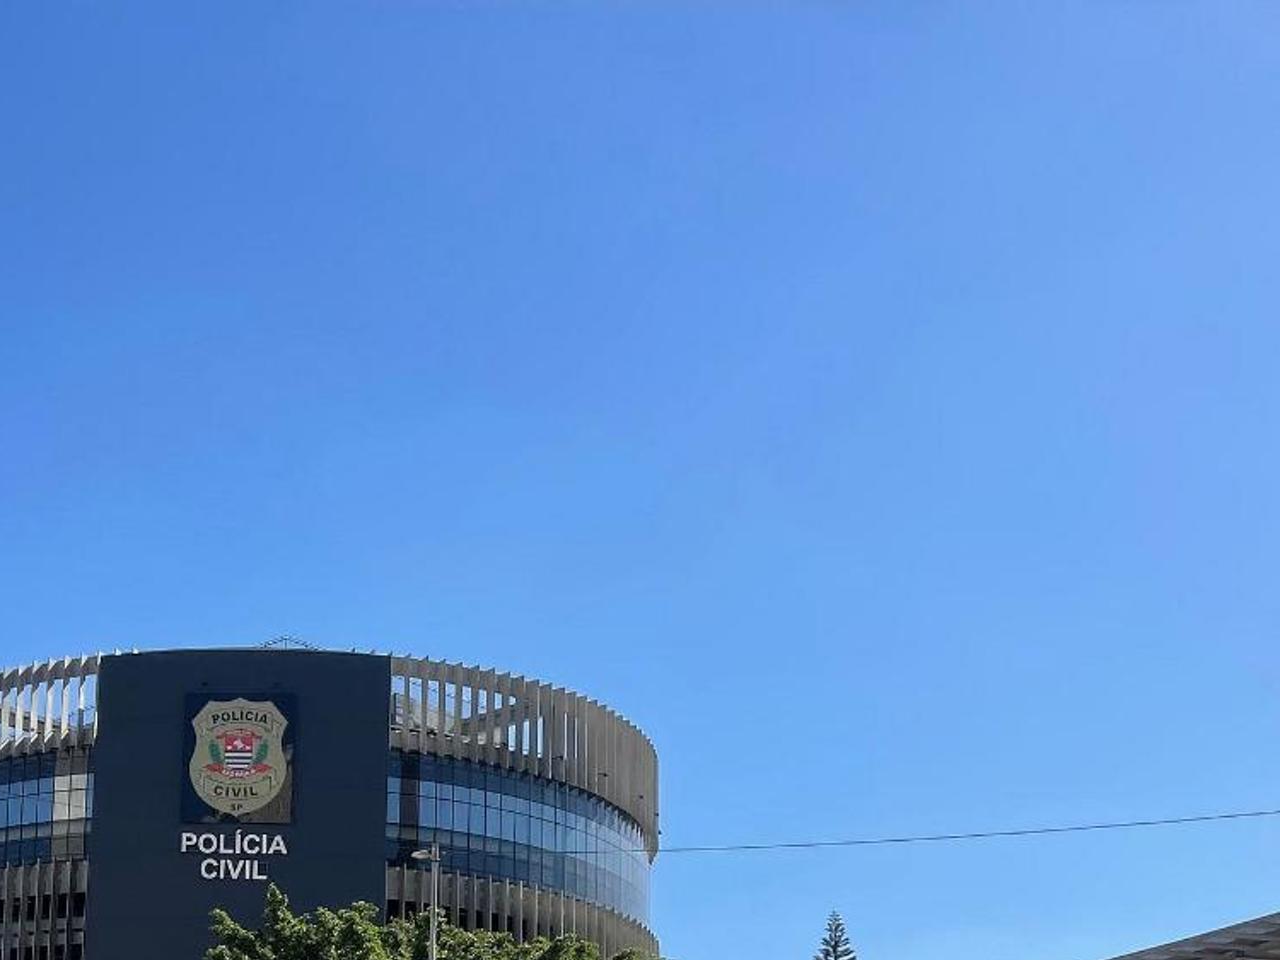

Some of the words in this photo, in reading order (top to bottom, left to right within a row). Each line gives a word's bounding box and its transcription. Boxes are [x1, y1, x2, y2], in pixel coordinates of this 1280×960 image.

[214, 786, 259, 797] CIVIL
[180, 828, 288, 854] POLÍCIA
[200, 858, 268, 880] CIVIL
